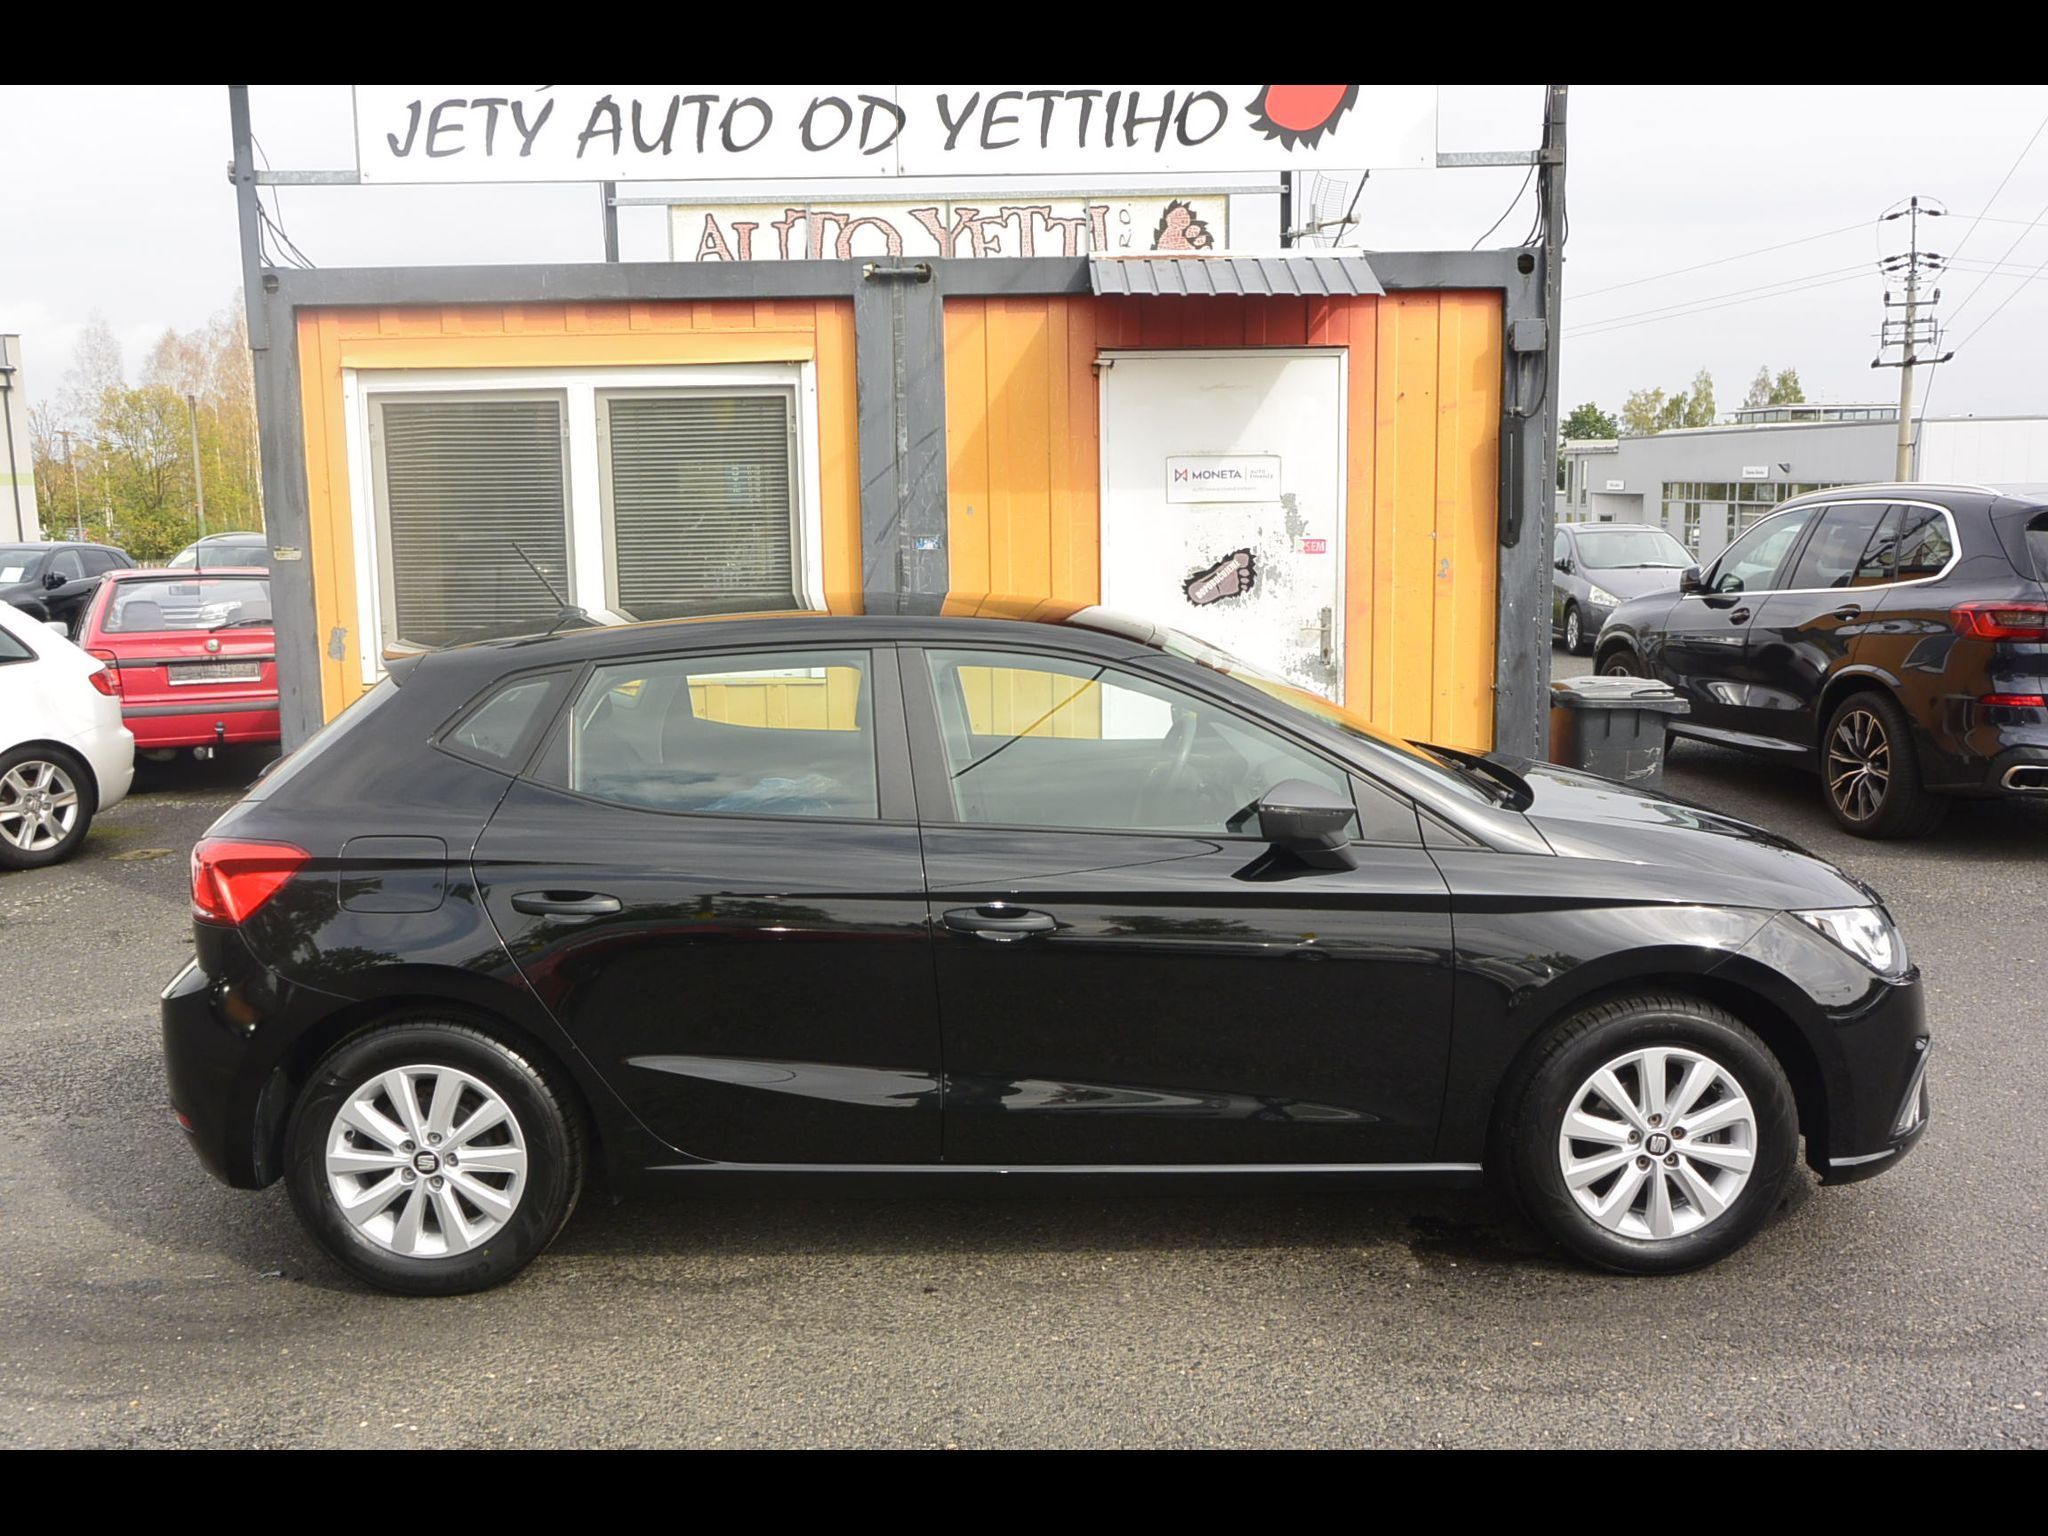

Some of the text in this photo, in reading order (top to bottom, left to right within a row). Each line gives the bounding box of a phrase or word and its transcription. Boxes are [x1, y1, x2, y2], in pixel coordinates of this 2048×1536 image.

[387, 85, 1229, 159] JETÝ AUTO OD YETTIHO
[696, 205, 1110, 262] AUTO YETTI
[1192, 469, 1242, 480] MONETA
